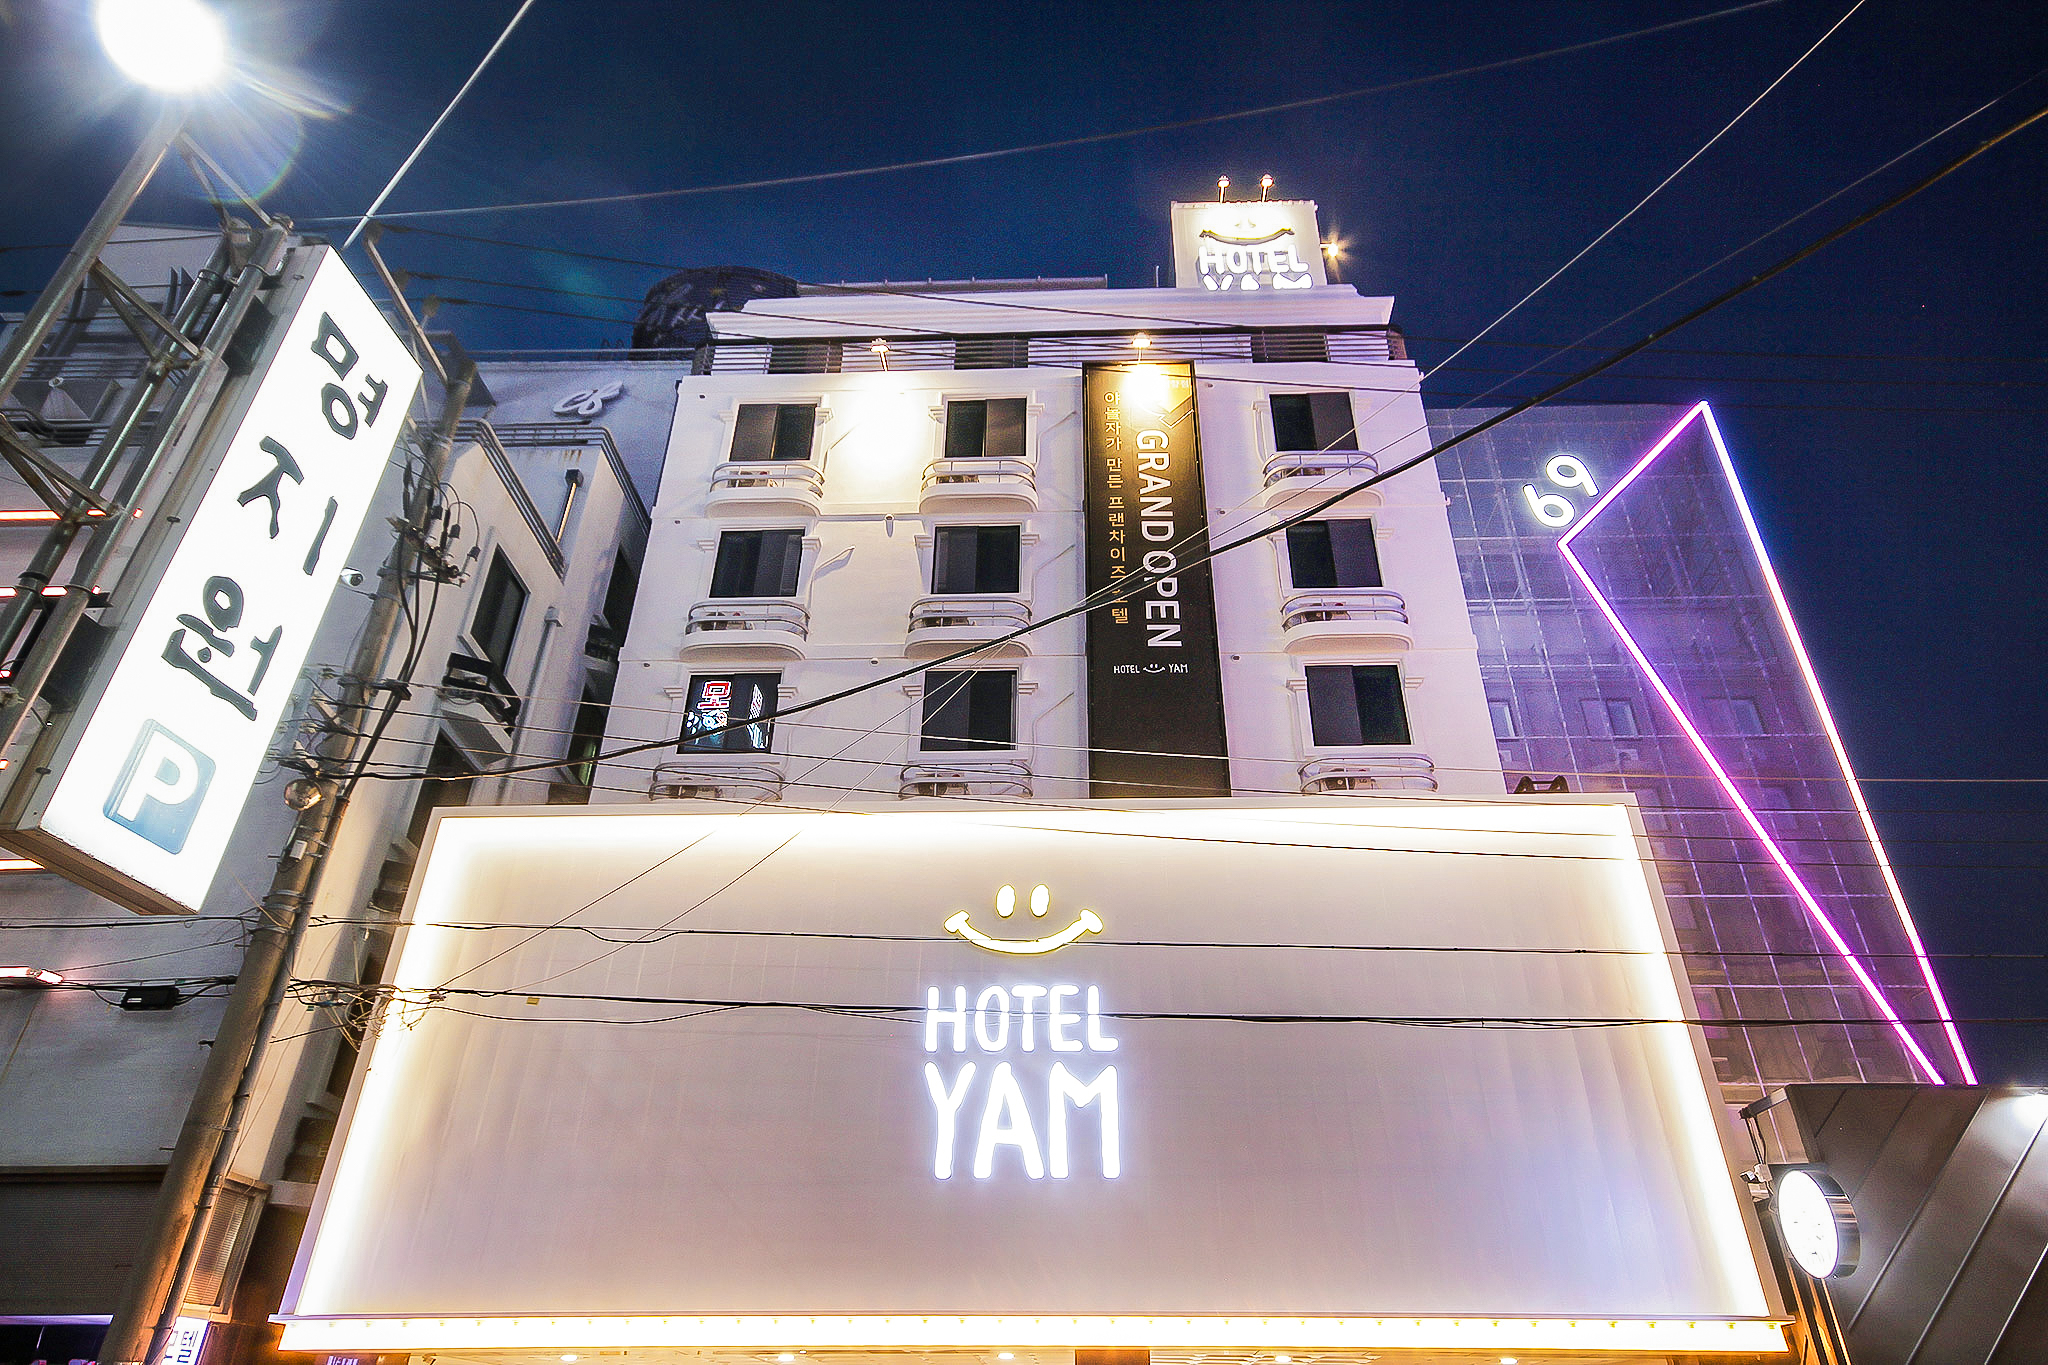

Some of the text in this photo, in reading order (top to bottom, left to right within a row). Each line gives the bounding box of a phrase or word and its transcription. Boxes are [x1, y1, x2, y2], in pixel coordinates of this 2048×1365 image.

[1199, 243, 1310, 275] HOTEL
[1106, 457, 1123, 489] 만든
[1107, 496, 1126, 579] 프랜차이즈
[1135, 429, 1183, 647] GRAND OPEN
[1113, 663, 1189, 674] HOTEL YAM
[924, 984, 1119, 1053] HOTEL
[924, 1061, 1121, 1180] YAM
